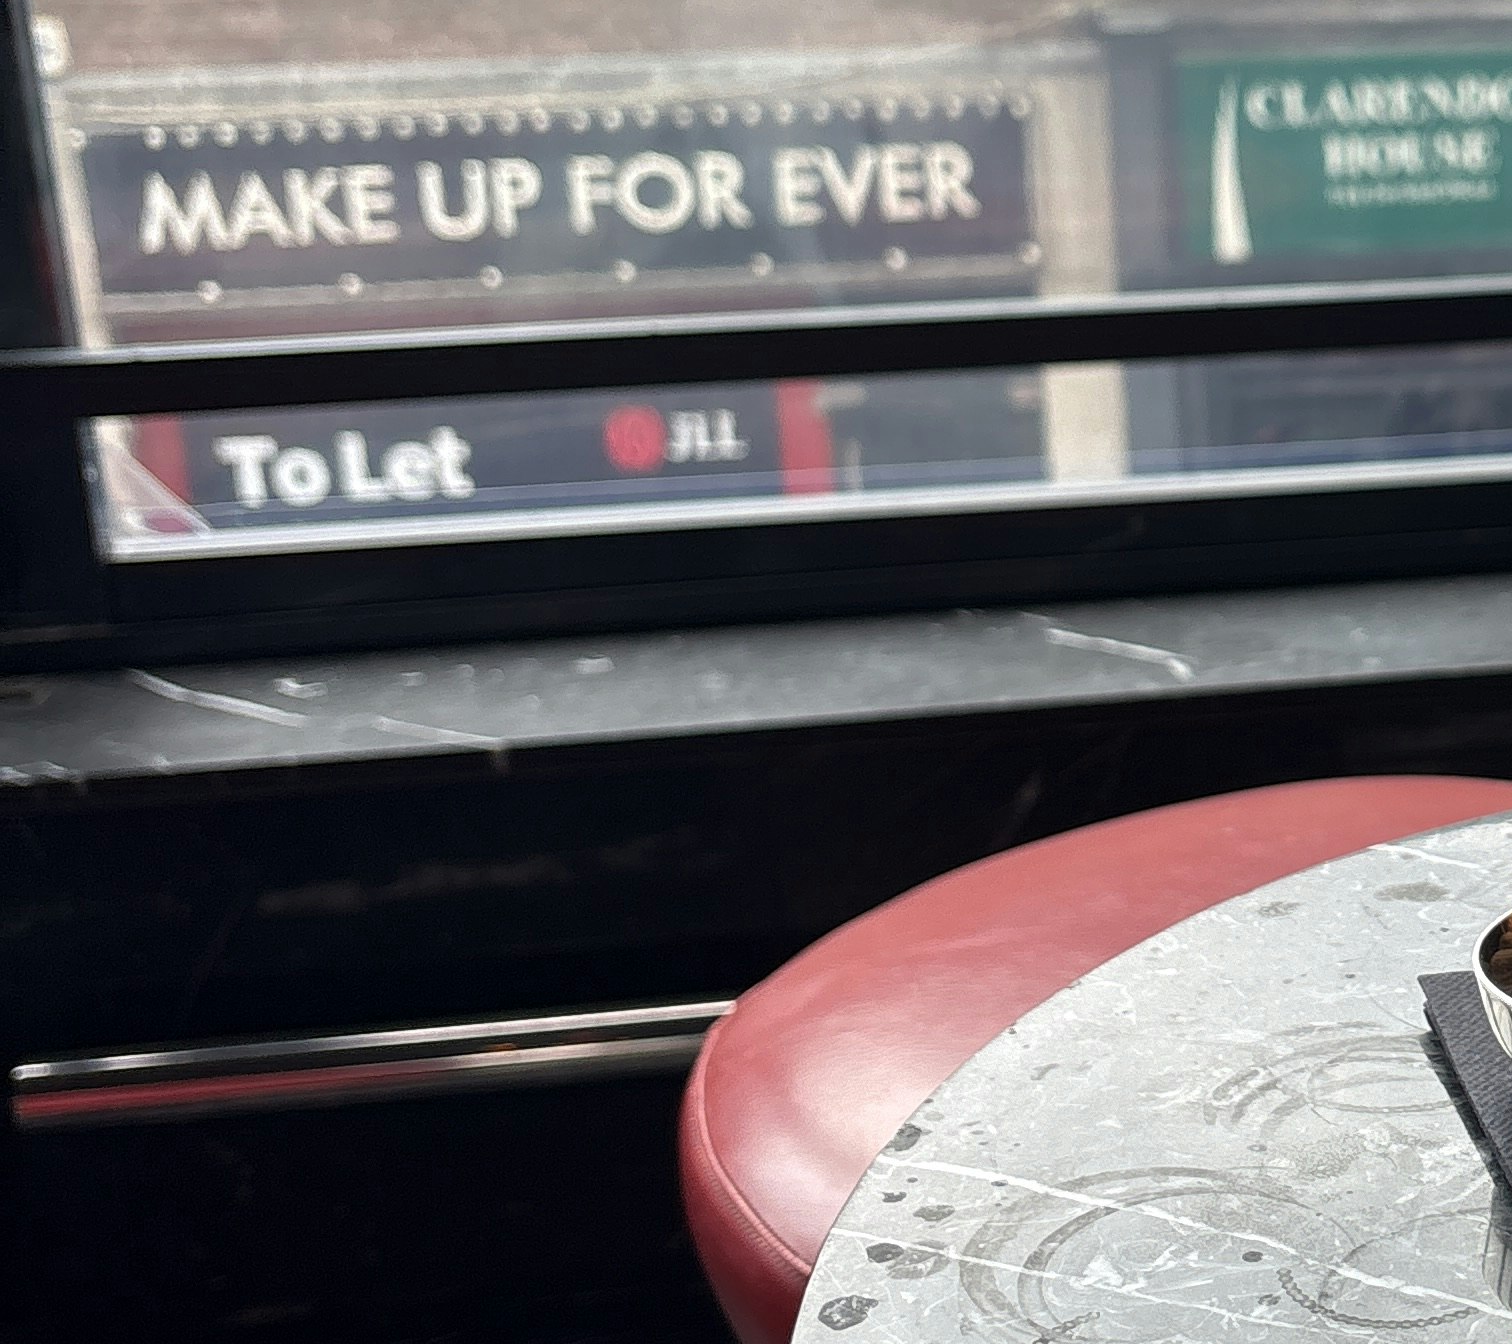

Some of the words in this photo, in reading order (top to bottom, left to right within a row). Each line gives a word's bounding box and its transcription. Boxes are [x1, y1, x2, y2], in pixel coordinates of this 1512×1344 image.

[137, 165, 400, 255] MAKE
[414, 156, 544, 243] UP
[566, 149, 756, 235] FOR
[770, 140, 983, 229] EVER
[211, 434, 332, 508] To
[331, 424, 478, 503] Let
